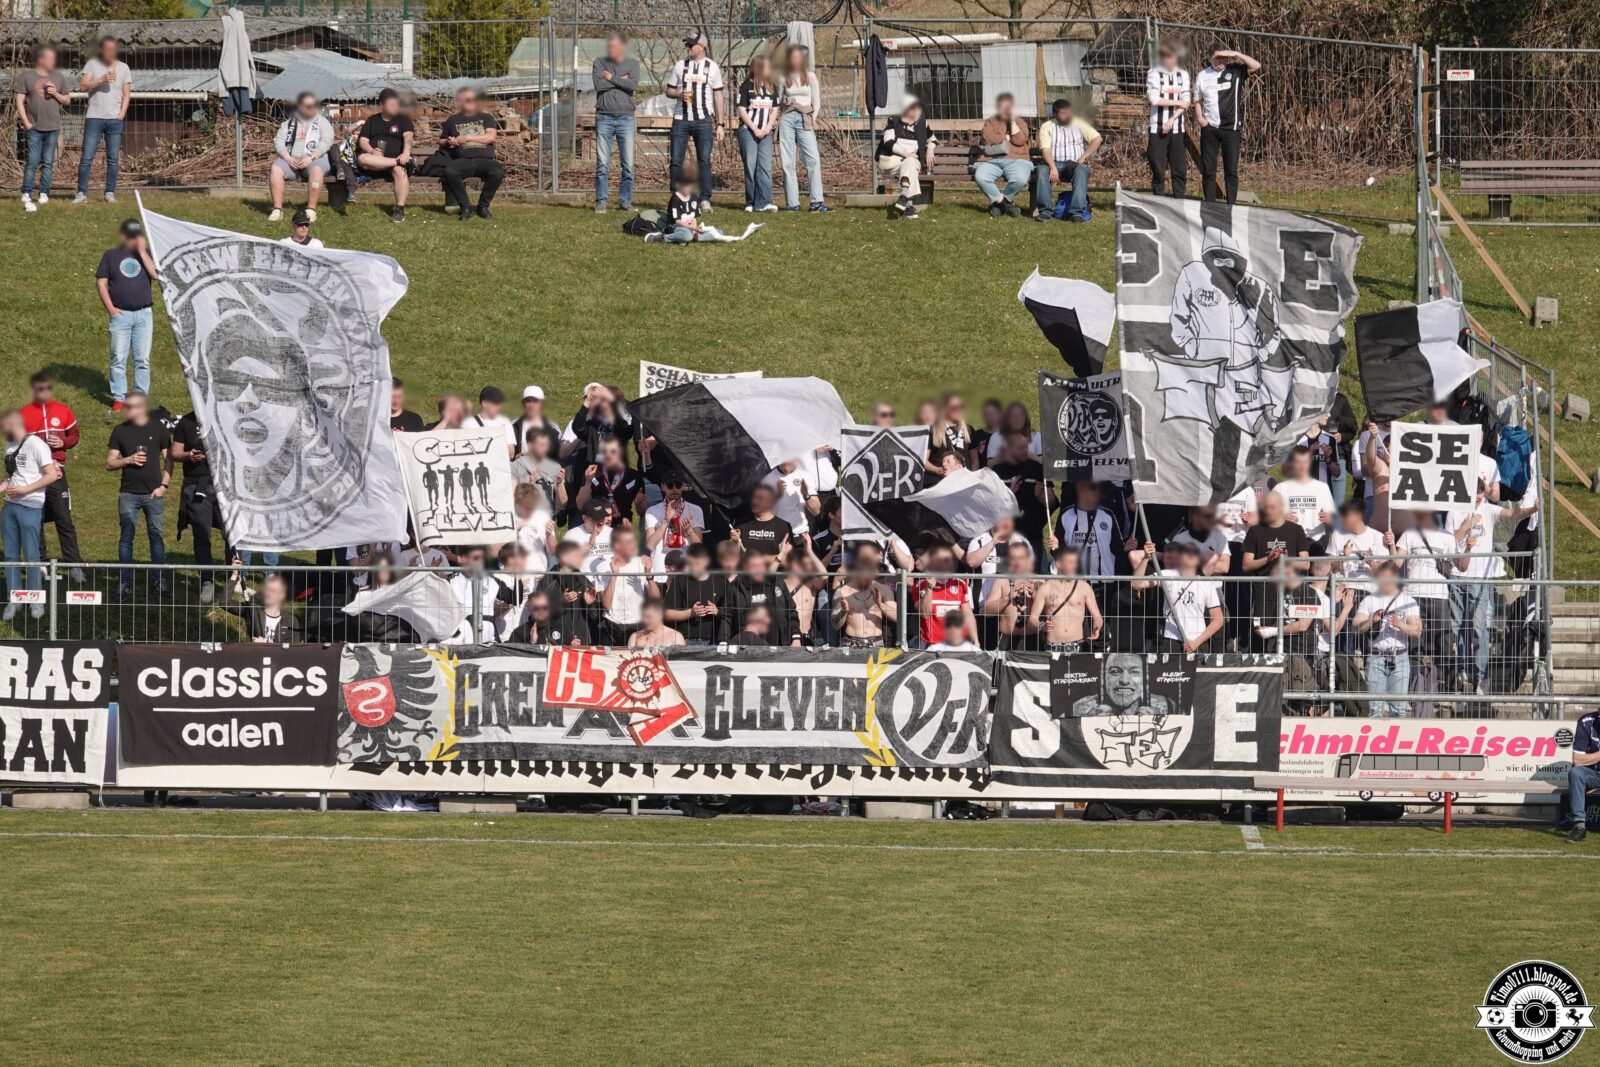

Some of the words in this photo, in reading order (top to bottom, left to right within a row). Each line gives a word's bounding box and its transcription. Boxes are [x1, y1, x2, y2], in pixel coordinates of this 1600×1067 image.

[1053, 459, 1091, 468] CREW
[1399, 431, 1470, 466] SE
[1391, 468, 1471, 503] AA
[749, 529, 775, 538] aalen
[137, 656, 328, 698] classics
[701, 664, 871, 741] ELEVEN
[182, 718, 284, 749] aalen
[1215, 683, 1259, 763] E
[1506, 764, 1520, 772] wie
[1521, 764, 1533, 772] die
[1536, 764, 1568, 774] Könige!
